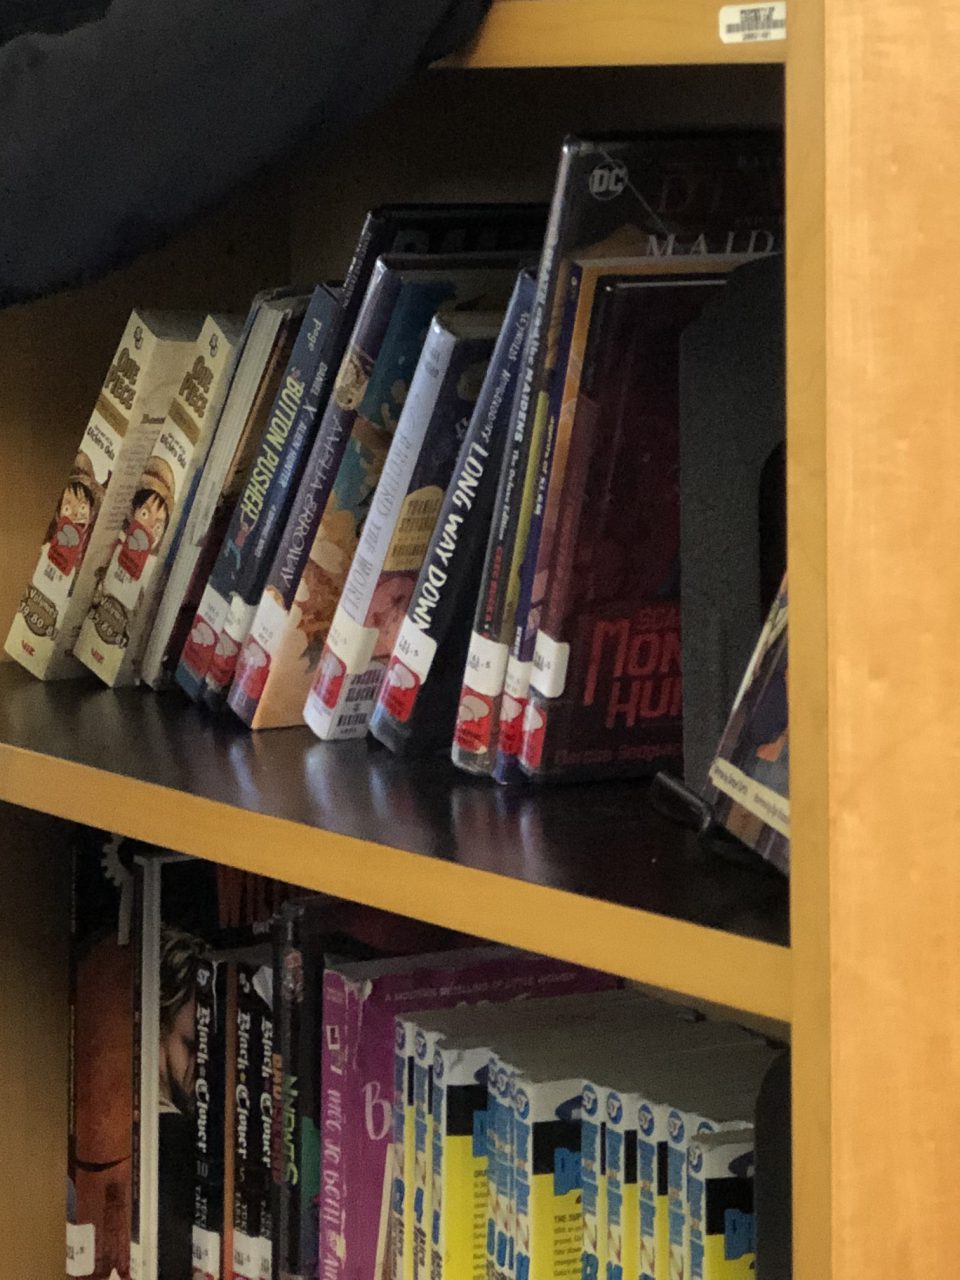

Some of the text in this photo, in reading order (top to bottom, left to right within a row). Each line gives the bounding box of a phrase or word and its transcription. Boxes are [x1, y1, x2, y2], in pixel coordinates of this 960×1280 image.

[590, 166, 626, 193] DC
[104, 364, 136, 410] PIECE
[117, 347, 140, 386] ONE
[178, 371, 208, 418] PIECE
[192, 355, 214, 394] ONE
[266, 375, 305, 452] BUTTON
[514, 367, 534, 443] MAIDENS
[240, 443, 279, 521] PUSHER
[452, 442, 489, 512] LONG
[435, 513, 464, 568] WAY
[197, 1002, 211, 1064] Black
[238, 1009, 251, 1070] Black
[195, 1078, 210, 1153] Clover
[236, 1083, 250, 1159] Clover
[260, 1016, 273, 1168] Black Clover
